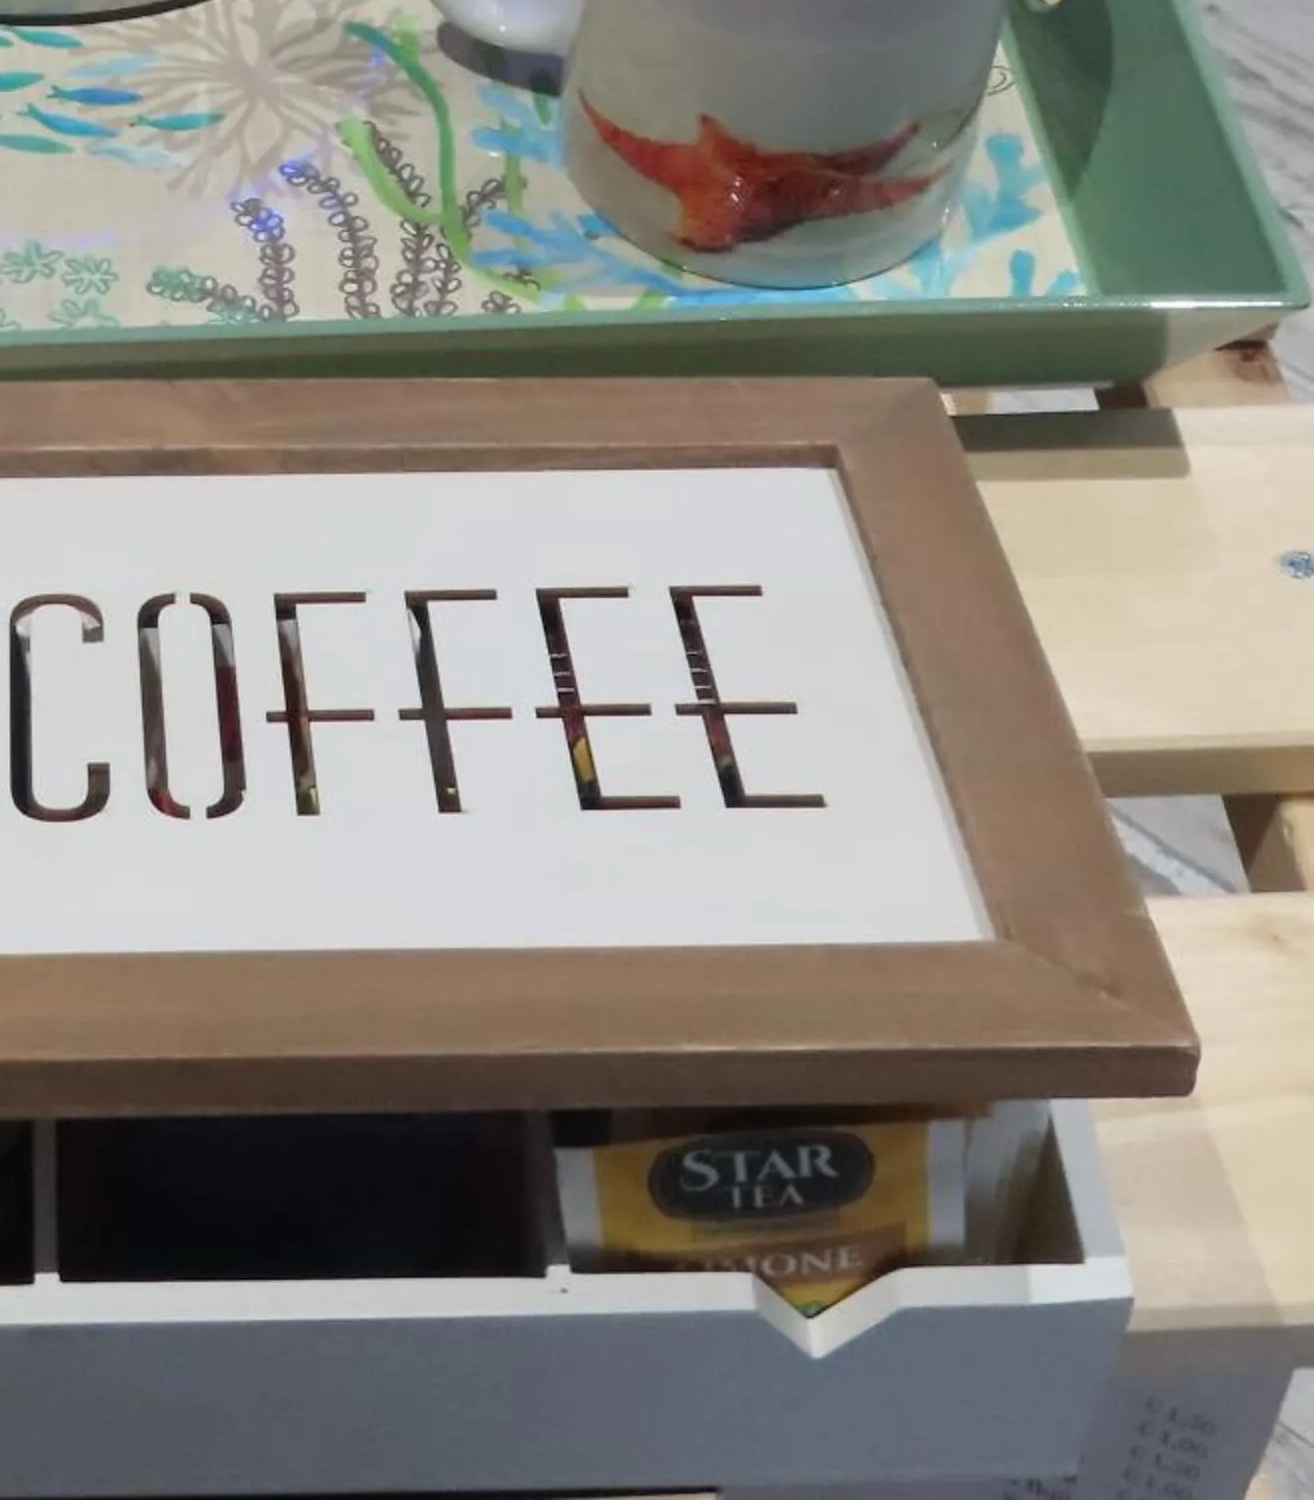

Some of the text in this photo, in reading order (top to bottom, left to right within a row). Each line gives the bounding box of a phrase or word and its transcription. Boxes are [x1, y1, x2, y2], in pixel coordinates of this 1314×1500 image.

[8, 584, 827, 823] COFFEE
[680, 1143, 839, 1192] STAR
[731, 1183, 805, 1210] TEA
